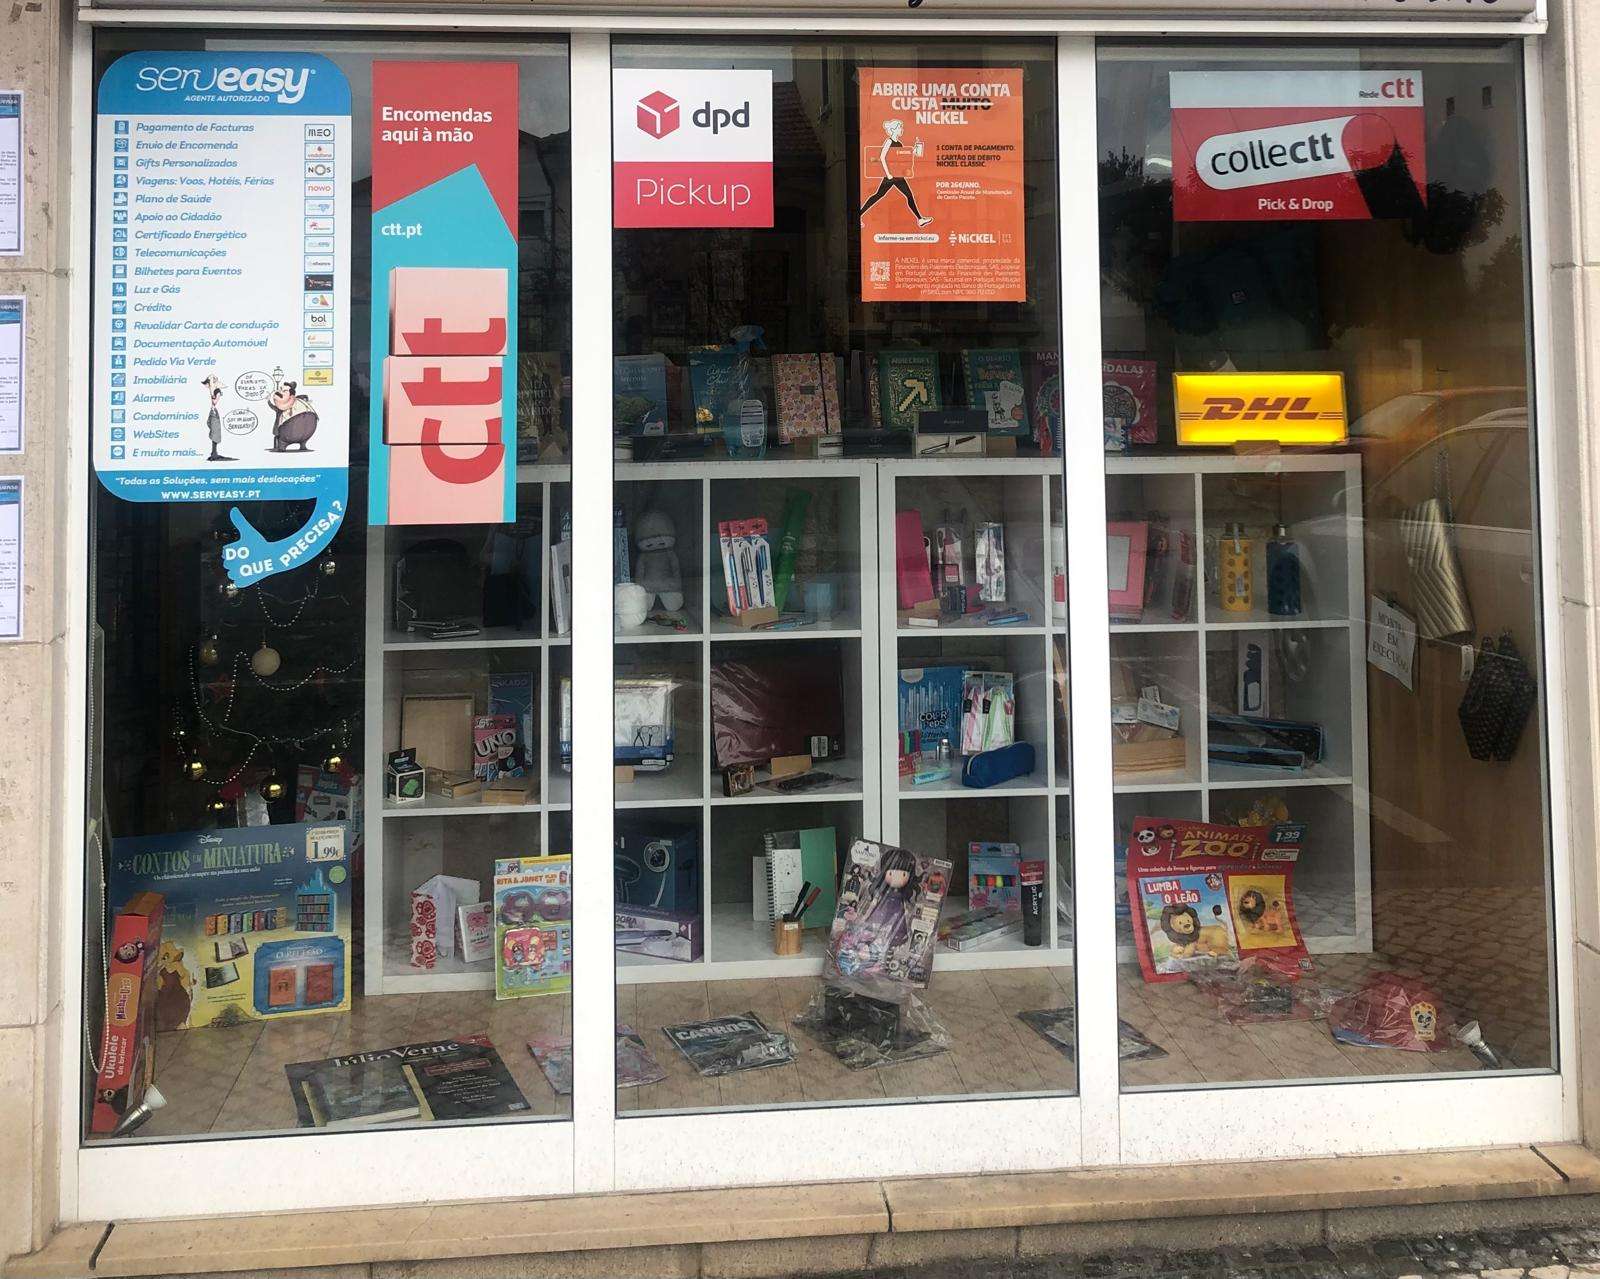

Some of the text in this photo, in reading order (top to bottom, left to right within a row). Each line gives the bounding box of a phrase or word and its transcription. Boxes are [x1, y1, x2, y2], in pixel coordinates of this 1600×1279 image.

[872, 83, 1011, 97] ABRIR UMA CONTA
[1359, 78, 1414, 99] Rede ctt
[184, 95, 270, 103] AGENTE AUTORIZADO
[892, 97, 938, 110] CUSTA
[382, 106, 493, 123] Encomendas
[692, 101, 750, 135] dpd
[915, 111, 968, 125] NICKEL
[136, 123, 254, 133] Pagamento de Facturas
[308, 128, 331, 137] MEO
[381, 127, 474, 144] aqui à mão
[136, 141, 238, 150] Envio de Encomenda
[1211, 132, 1336, 176] collectt
[136, 158, 238, 169] Gifts Personalizados
[308, 164, 332, 176] NOS
[136, 176, 275, 187] Viagens: Voos, Hotéis, Férias
[136, 194, 212, 203] Plano de Saúde
[637, 178, 751, 211] Pickup
[1258, 198, 1333, 212] Pick & Drop
[135, 212, 222, 223] Apoio ao Cidadão
[135, 230, 247, 241] Certificado Energético
[381, 223, 423, 239] ctt.pt
[135, 248, 227, 259] Telecomunicações
[134, 266, 242, 278] Bilhetes para Eventos
[134, 285, 151, 293] Luz
[162, 284, 181, 294] Gás
[134, 302, 172, 312] Crédito
[311, 314, 327, 323] bol
[134, 320, 280, 331] Revalidar Carta de condução
[134, 338, 268, 350] Documentação Automóvel
[133, 357, 216, 366] Pedido Via Verde
[133, 375, 187, 385] Imobiliária
[133, 393, 175, 403] Alarmes
[401, 317, 507, 485] ctt
[1201, 397, 1320, 421] DHL
[133, 411, 199, 421] Condomínios
[133, 430, 180, 439] WebSites
[132, 449, 139, 457] E
[140, 448, 173, 457] muito
[163, 475, 208, 487] Soluções,
[210, 476, 231, 484] sem
[233, 475, 256, 484] mais
[161, 490, 261, 499] WWW.SERVEASY.PT
[226, 546, 250, 560] DO
[240, 558, 274, 577] QUE
[475, 730, 516, 758] UNO
[1184, 830, 1256, 843] ANIMAIS
[1176, 840, 1249, 859] ZOO
[133, 851, 190, 875] CONTOS
[203, 842, 283, 869] MINIATURA
[1147, 881, 1179, 894] LUMBA
[1164, 891, 1199, 904] O LEÃO
[616, 914, 637, 925] DORA
[391, 1043, 459, 1058] Verne
[105, 1035, 119, 1079] Ukulele
